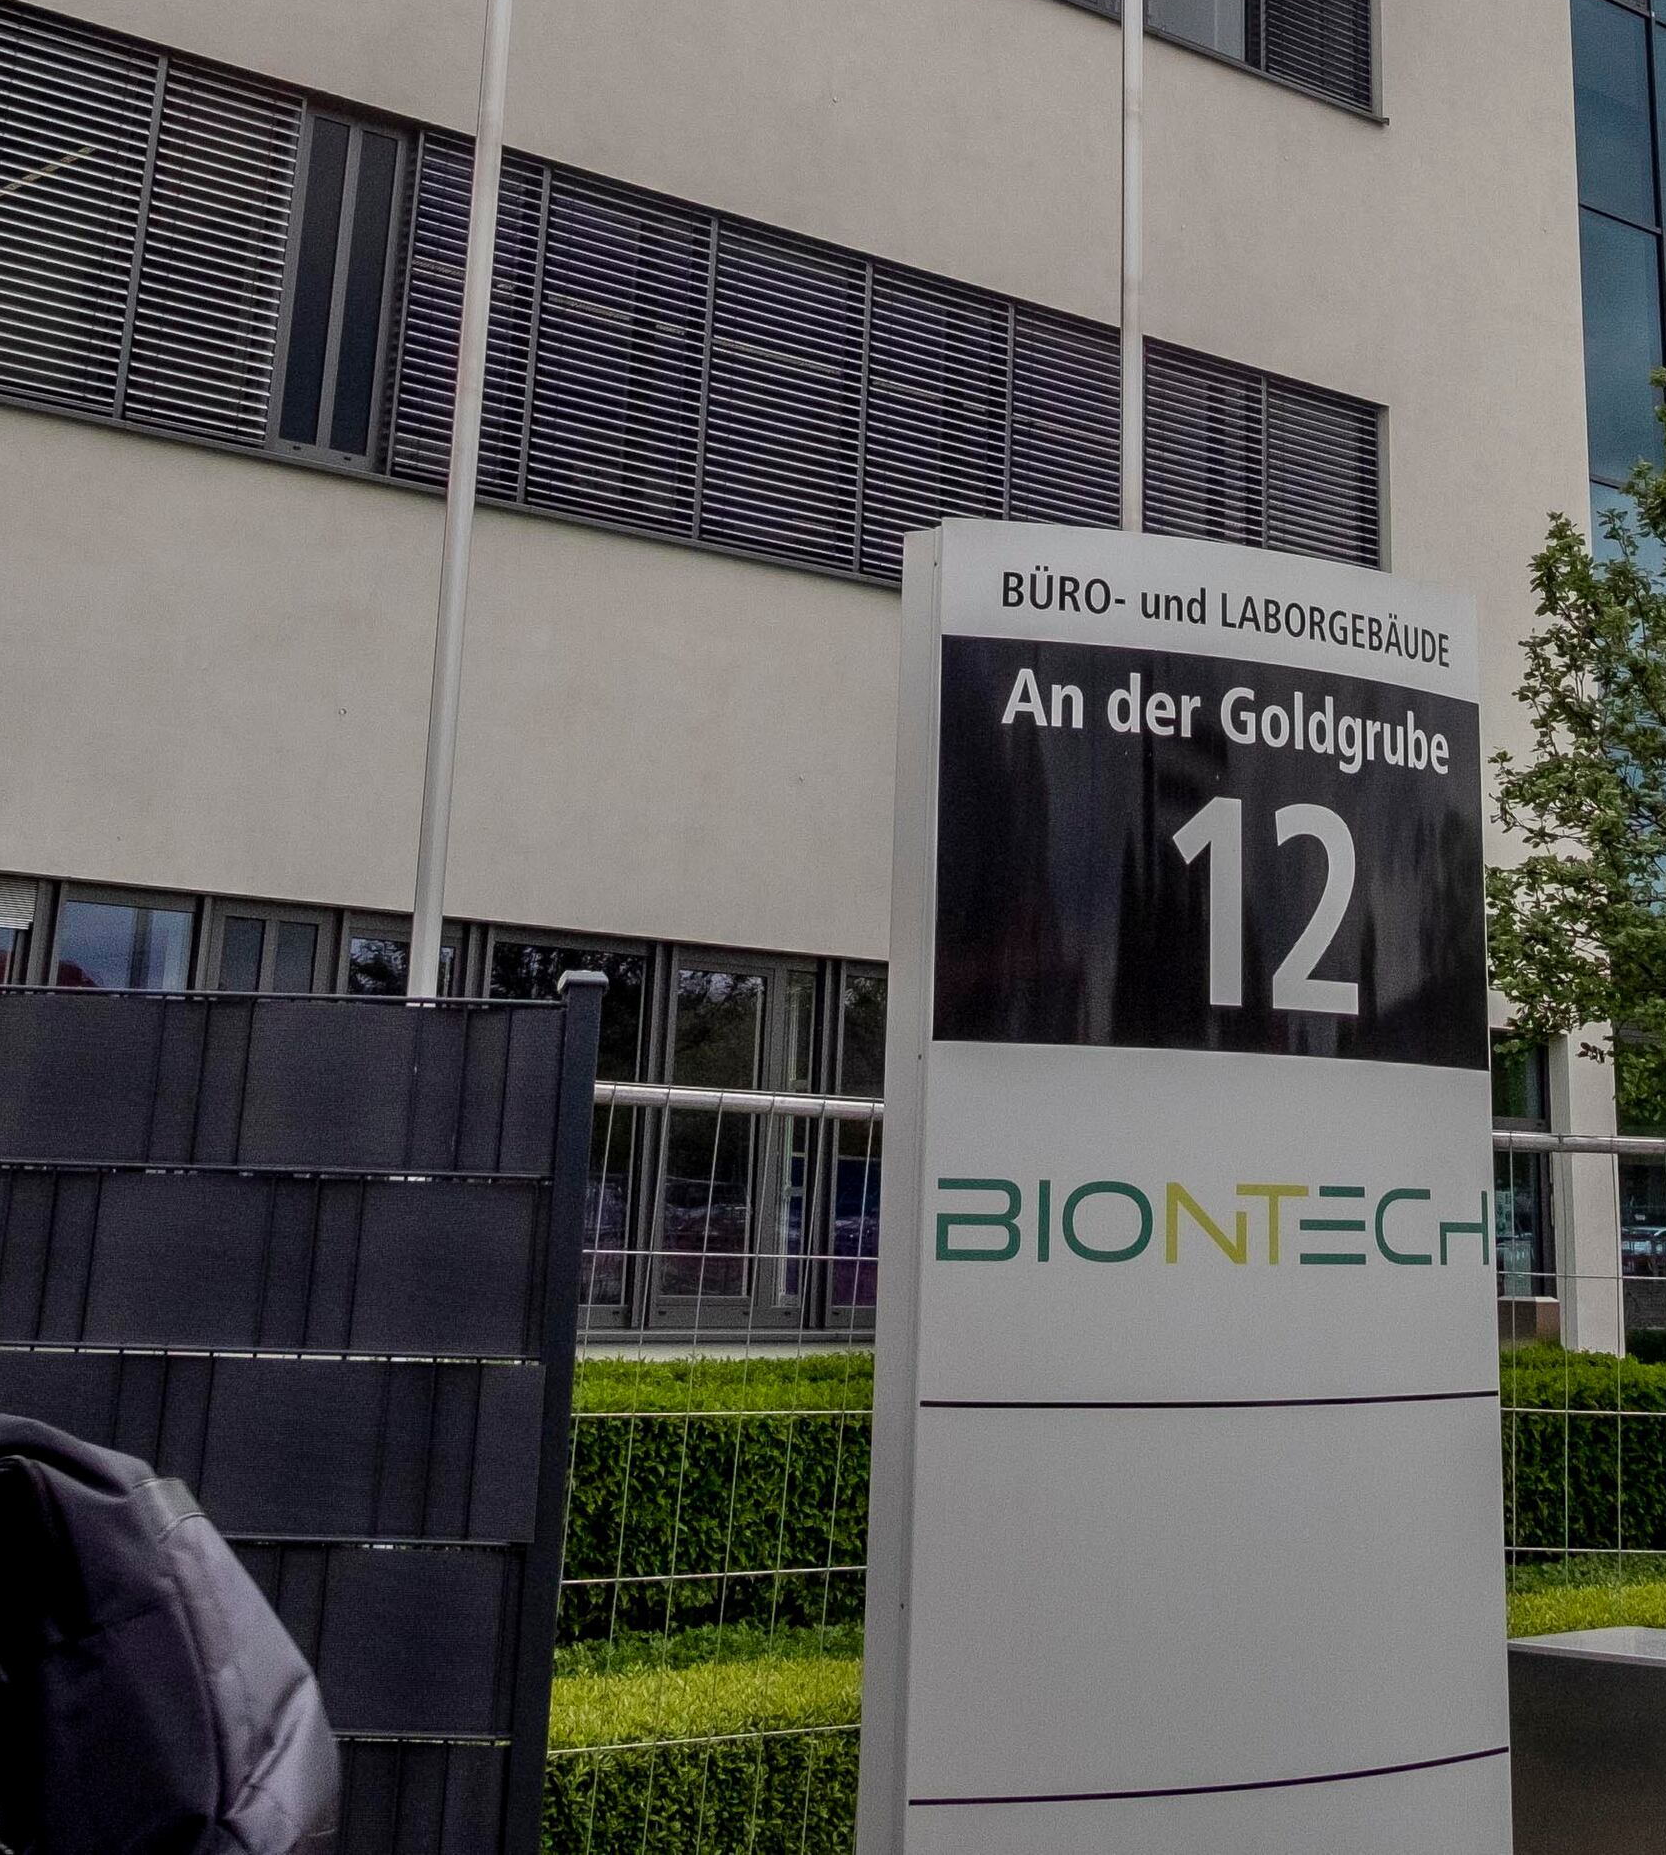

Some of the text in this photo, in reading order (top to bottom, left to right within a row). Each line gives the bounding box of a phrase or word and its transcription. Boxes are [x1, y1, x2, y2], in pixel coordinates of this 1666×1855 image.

[1002, 566, 1450, 667] BÜRO- und LABORGEBÄUDE
[1002, 668, 1450, 774] An der Goldgrube
[1172, 797, 1359, 1016] 12
[935, 1177, 1490, 1266] BIONTECH
